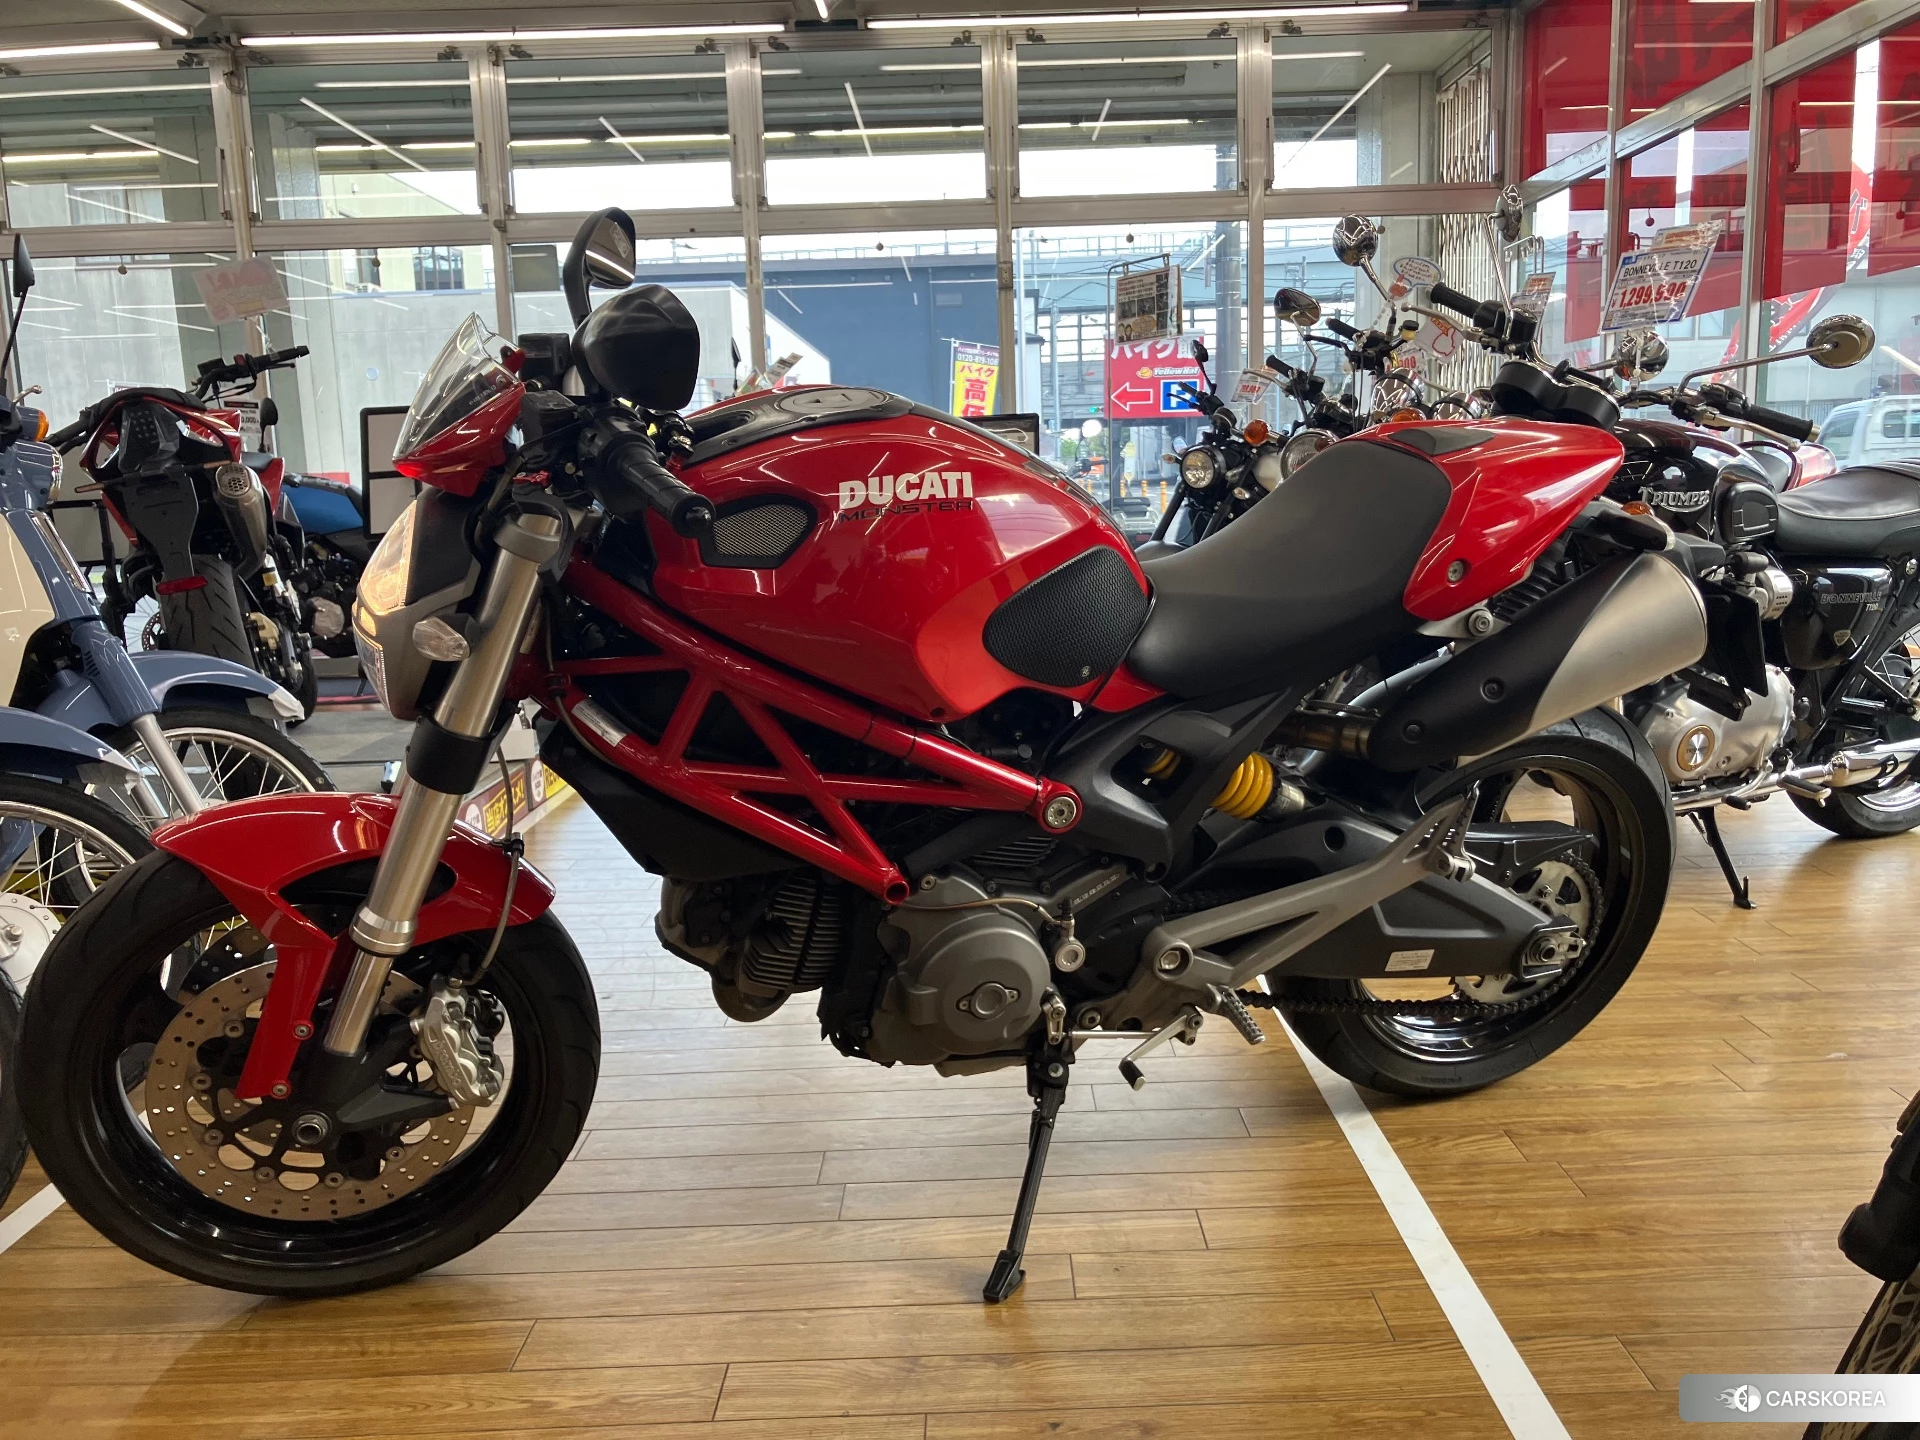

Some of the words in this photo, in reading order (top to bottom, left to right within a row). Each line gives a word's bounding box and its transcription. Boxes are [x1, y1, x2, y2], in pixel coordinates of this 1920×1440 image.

[1673, 259, 1698, 271] T120
[960, 365, 995, 378] バイク
[838, 471, 973, 510] DUCATI
[1638, 486, 1710, 508] TRIUMPH
[838, 501, 973, 524] MONSTER
[1820, 592, 1882, 604] BONNEVILLE
[432, 1040, 462, 1087] brembo
